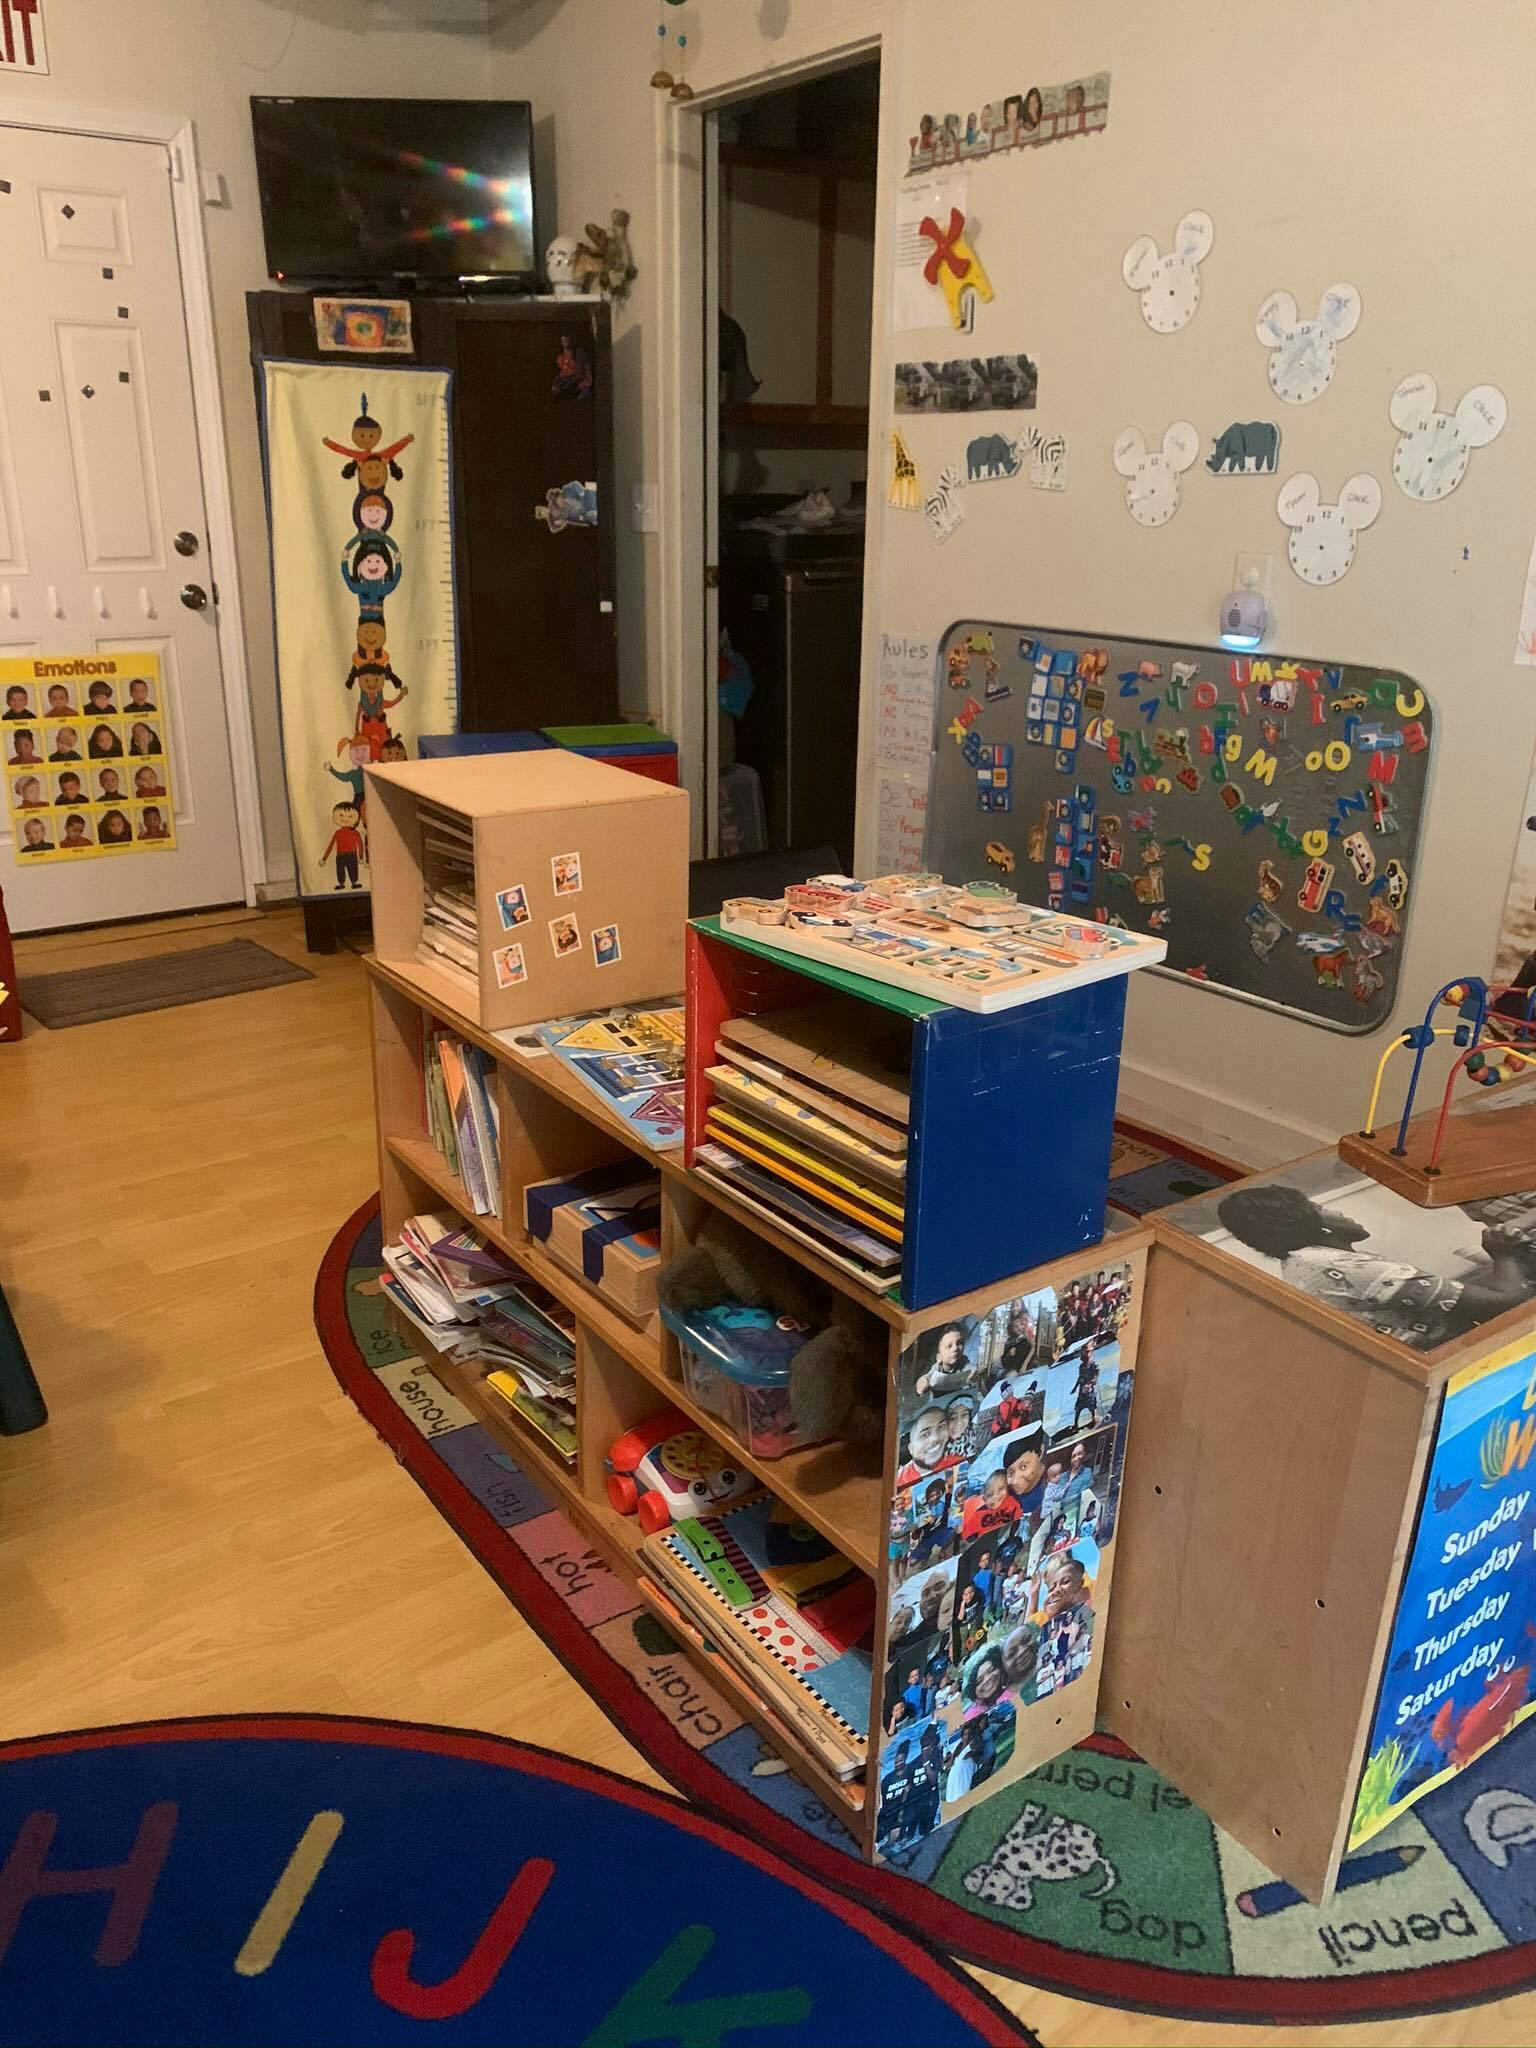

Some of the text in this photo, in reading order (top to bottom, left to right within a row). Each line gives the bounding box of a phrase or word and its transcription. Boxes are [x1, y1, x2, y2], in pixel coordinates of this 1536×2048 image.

[33, 659, 117, 678] Emotions
[881, 634, 929, 659] Rules
[1192, 843, 1212, 871] S
[399, 1379, 456, 1436] house
[1441, 1489, 1531, 1566] Sunday
[539, 1551, 595, 1597] hot
[1426, 1540, 1523, 1620] Tuesday
[1413, 1591, 1511, 1672] Thursday
[646, 1664, 723, 1736] chair
[1396, 1637, 1504, 1727] Saturday
[0, 1801, 813, 2048] H I J K
[1096, 1896, 1209, 1959] dog
[1316, 1898, 1479, 1969] pencil
